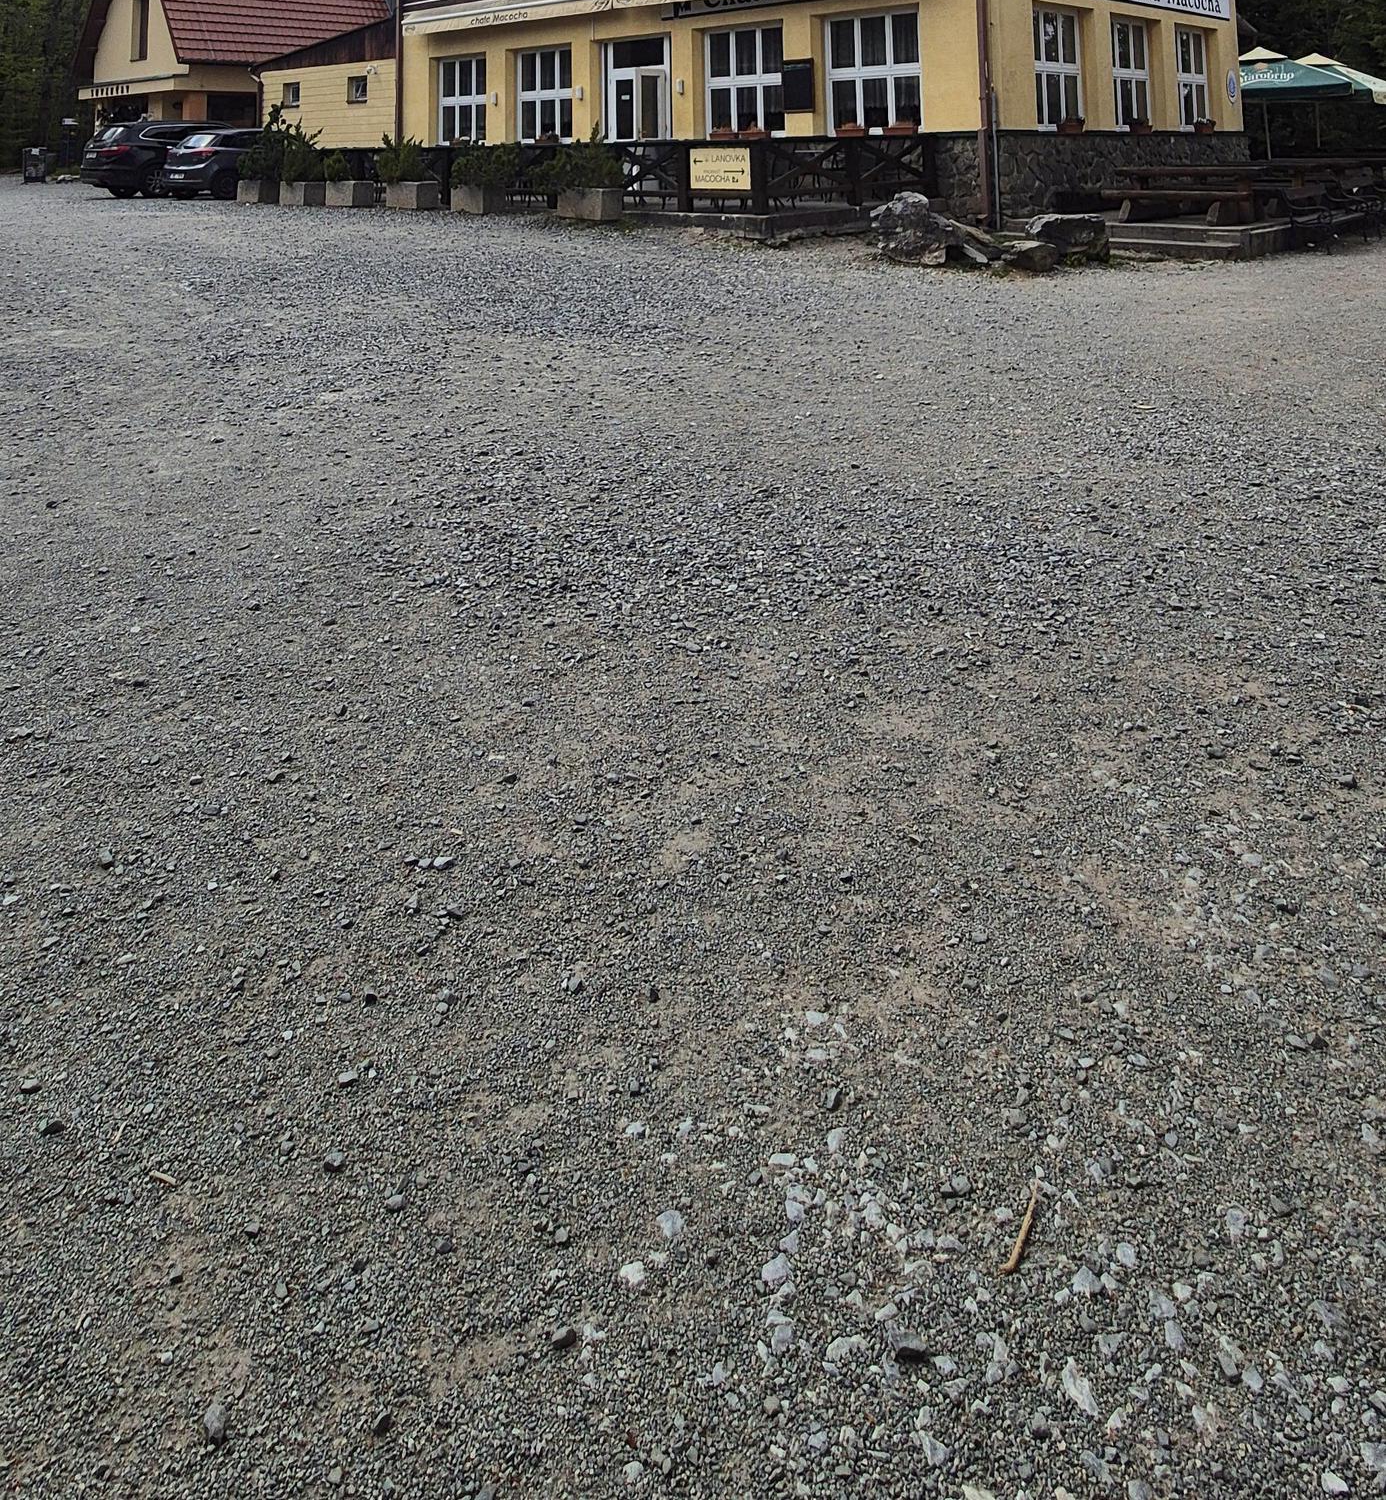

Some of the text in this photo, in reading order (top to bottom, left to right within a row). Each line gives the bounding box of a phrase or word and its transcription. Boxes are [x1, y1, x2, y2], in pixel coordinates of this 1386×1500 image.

[492, 11, 529, 23] Macocha
[711, 154, 746, 163] LANOVKA
[695, 174, 731, 183] MACOCHA
